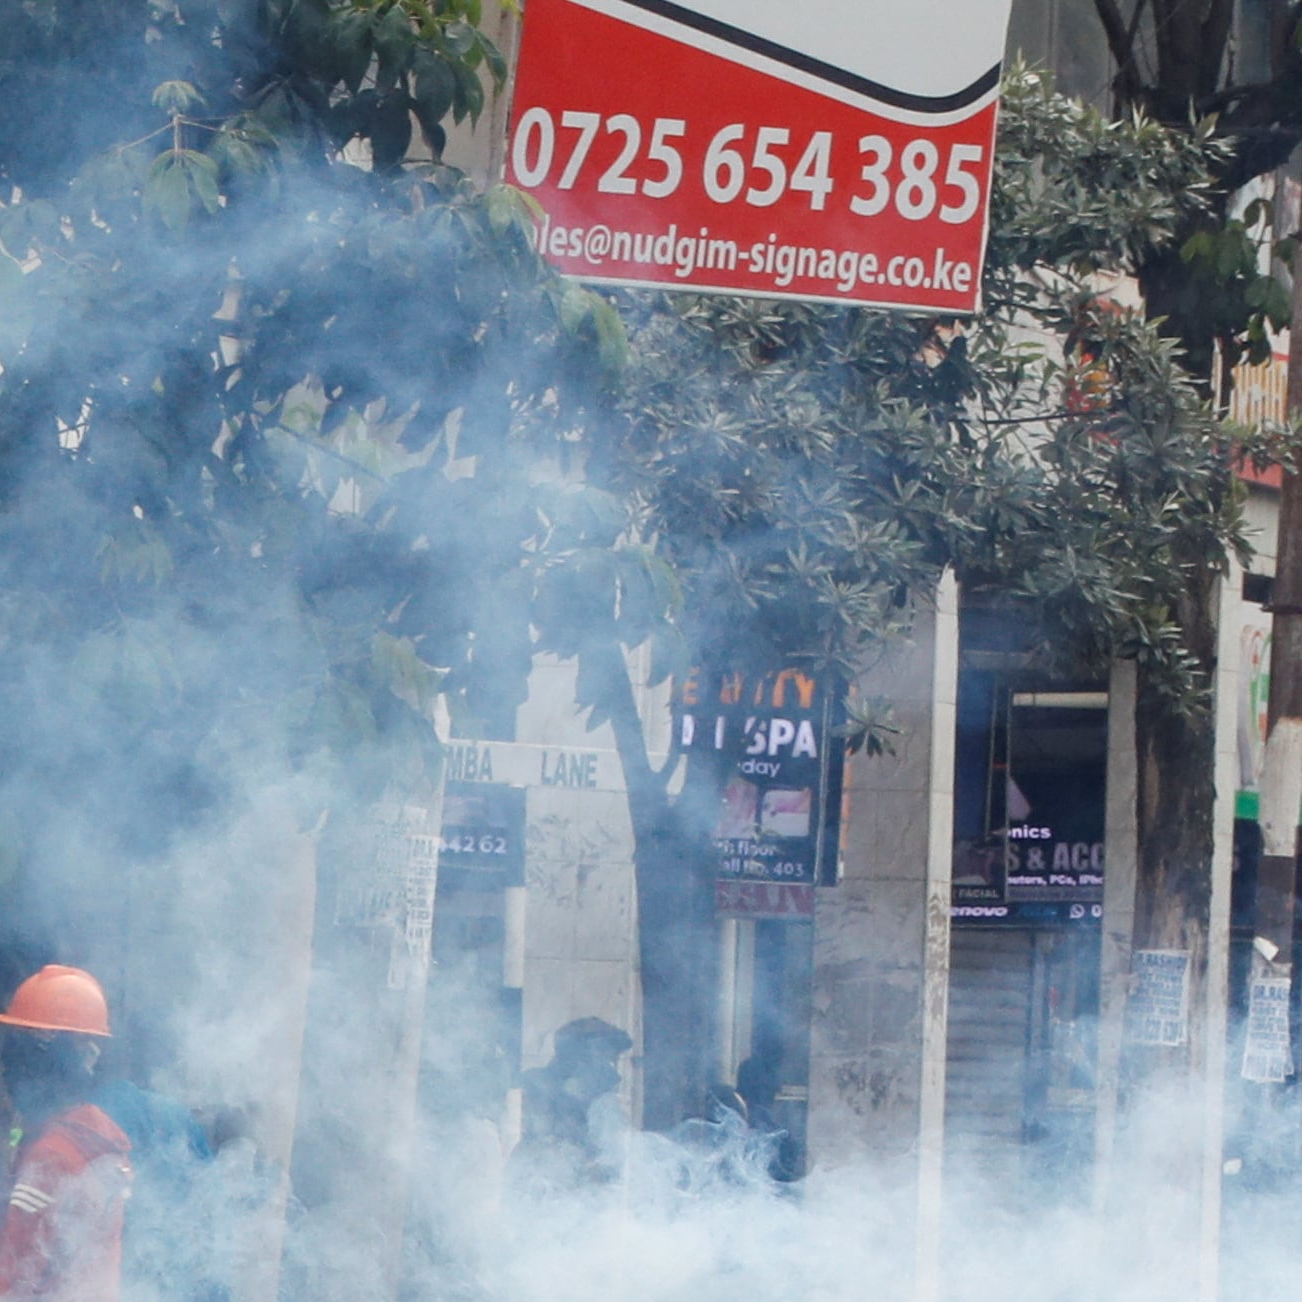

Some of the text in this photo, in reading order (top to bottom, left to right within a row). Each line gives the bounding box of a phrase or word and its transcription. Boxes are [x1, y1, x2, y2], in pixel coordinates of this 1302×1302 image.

[512, 107, 983, 224] 0725 654 385
[533, 214, 972, 292] les@nudgim-signage.co.ke
[446, 745, 598, 788] MBA LANE
[1007, 842, 1105, 871] S & ACC
[950, 905, 1008, 917] enovo
[1091, 904, 1103, 918] 0
